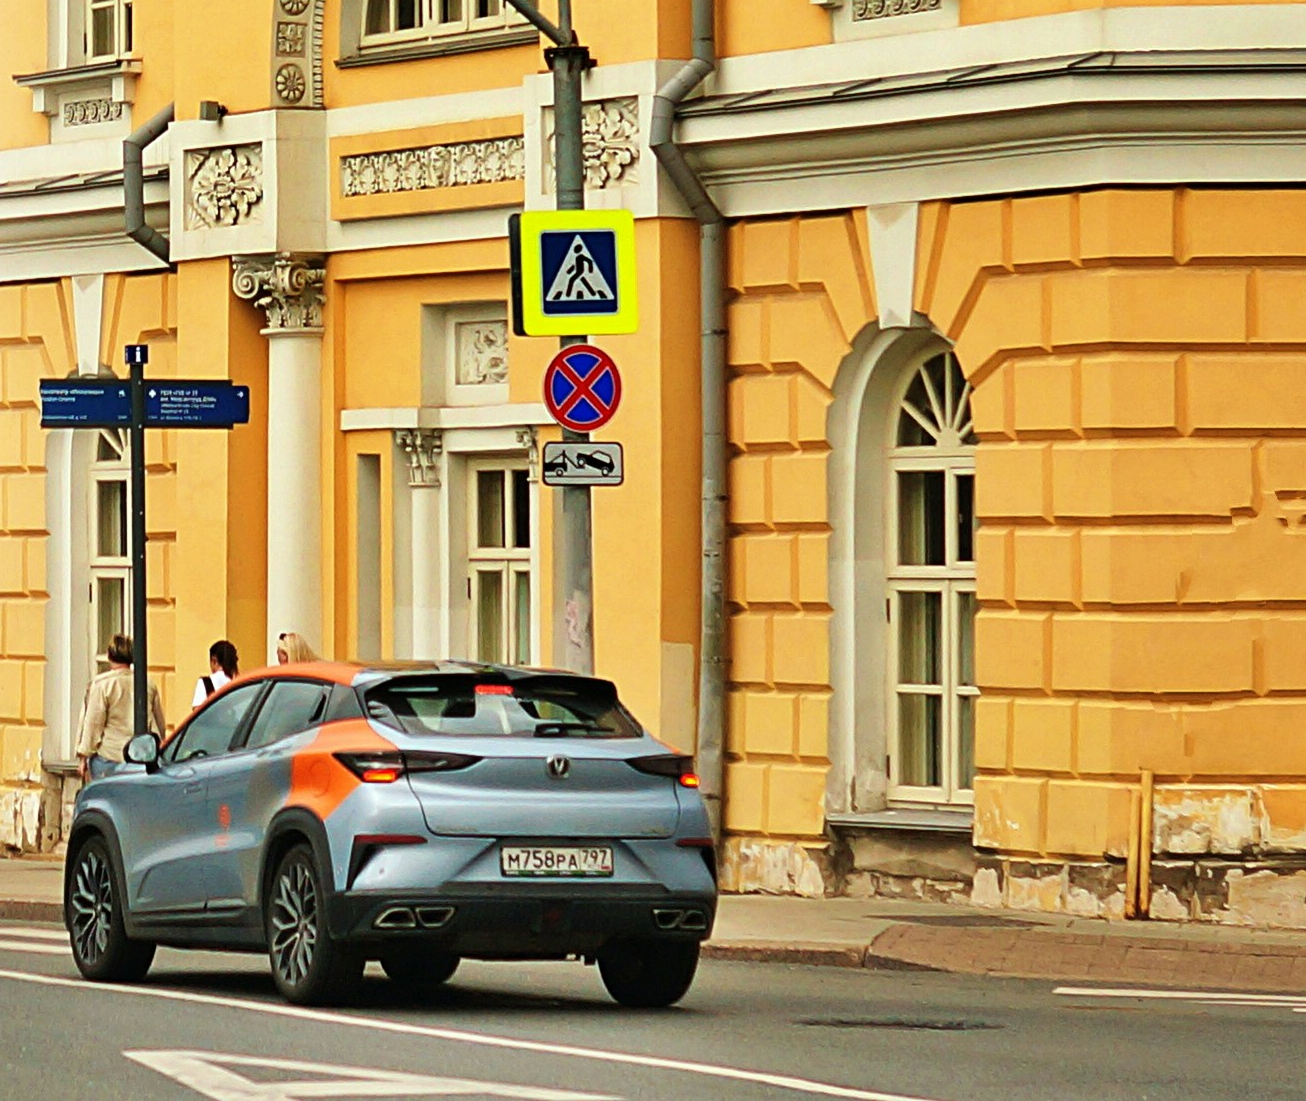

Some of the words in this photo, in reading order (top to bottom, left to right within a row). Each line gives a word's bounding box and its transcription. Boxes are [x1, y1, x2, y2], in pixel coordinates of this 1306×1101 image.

[135, 346, 142, 363] i
[507, 849, 579, 869] М758РА
[581, 849, 608, 865] 797
